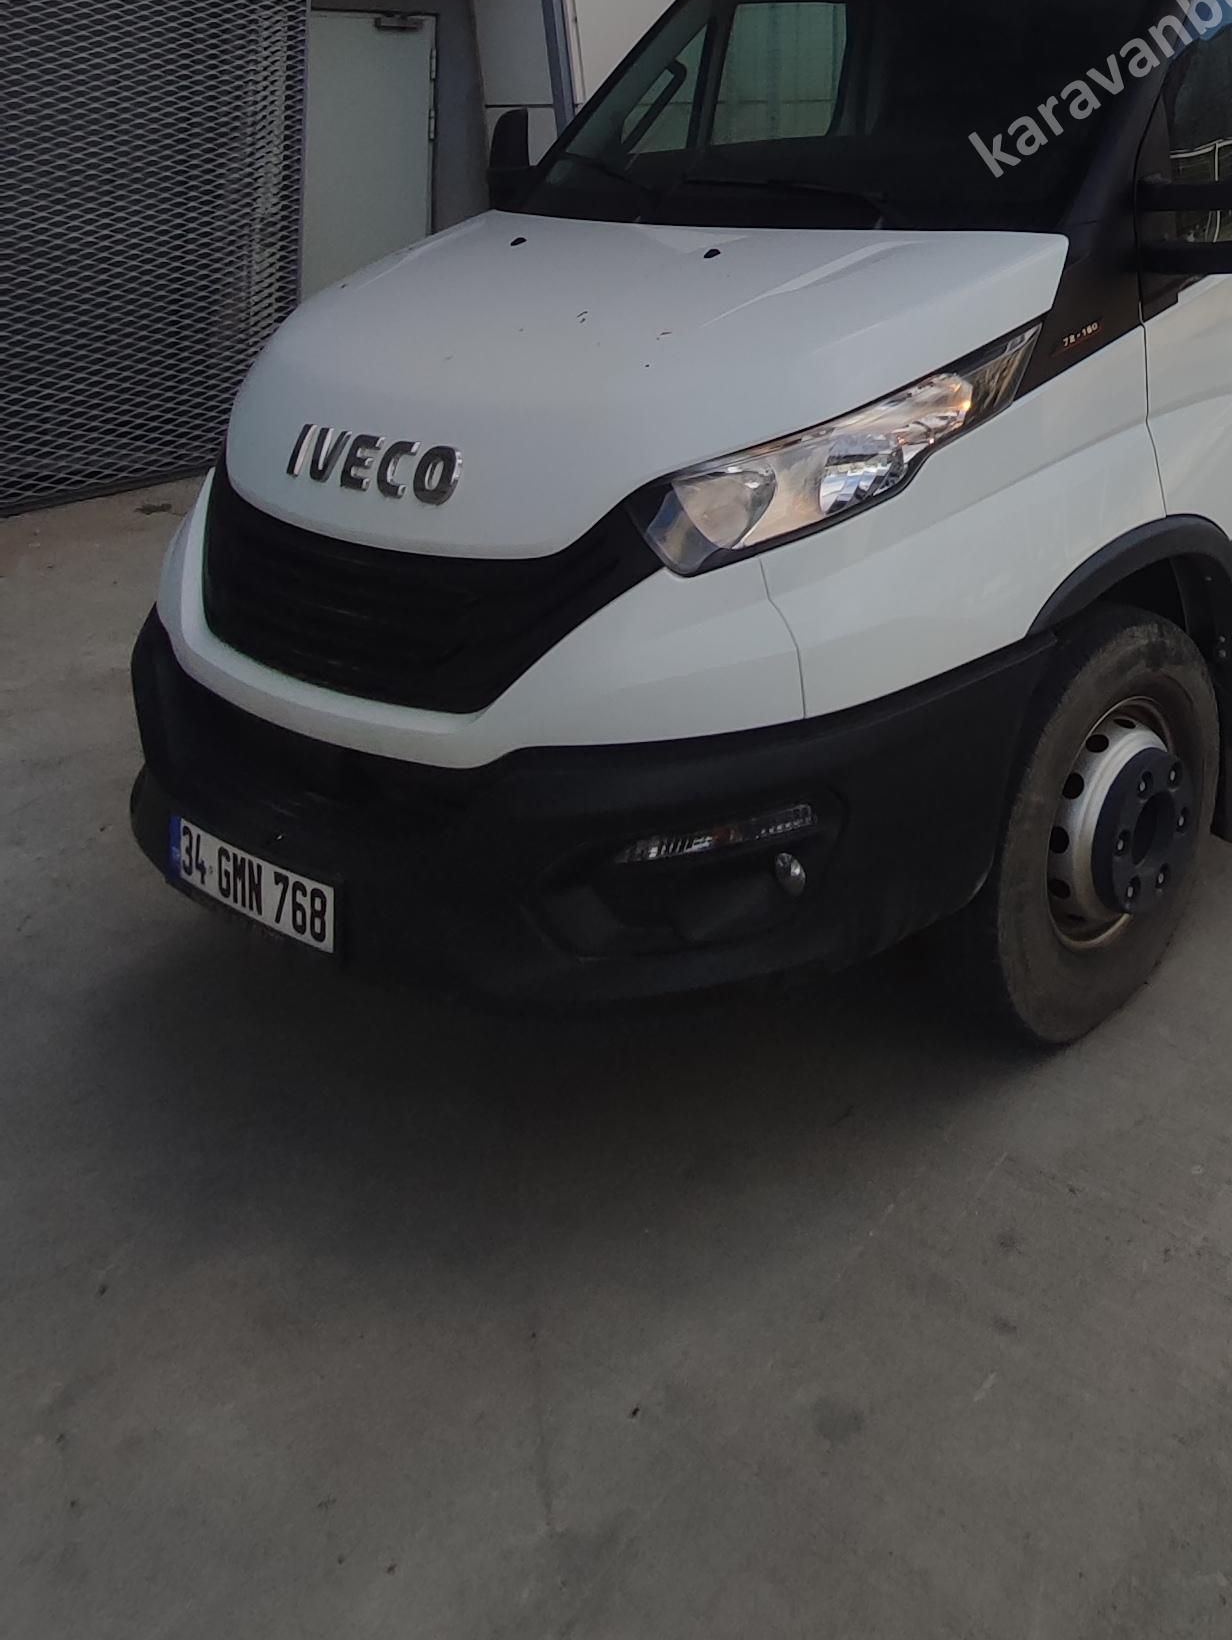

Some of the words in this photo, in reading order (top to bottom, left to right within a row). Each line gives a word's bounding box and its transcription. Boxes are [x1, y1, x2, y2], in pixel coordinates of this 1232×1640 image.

[286, 424, 463, 506] IVECO
[182, 826, 207, 885] 34
[218, 846, 262, 916] GMN
[274, 871, 327, 943] 768
